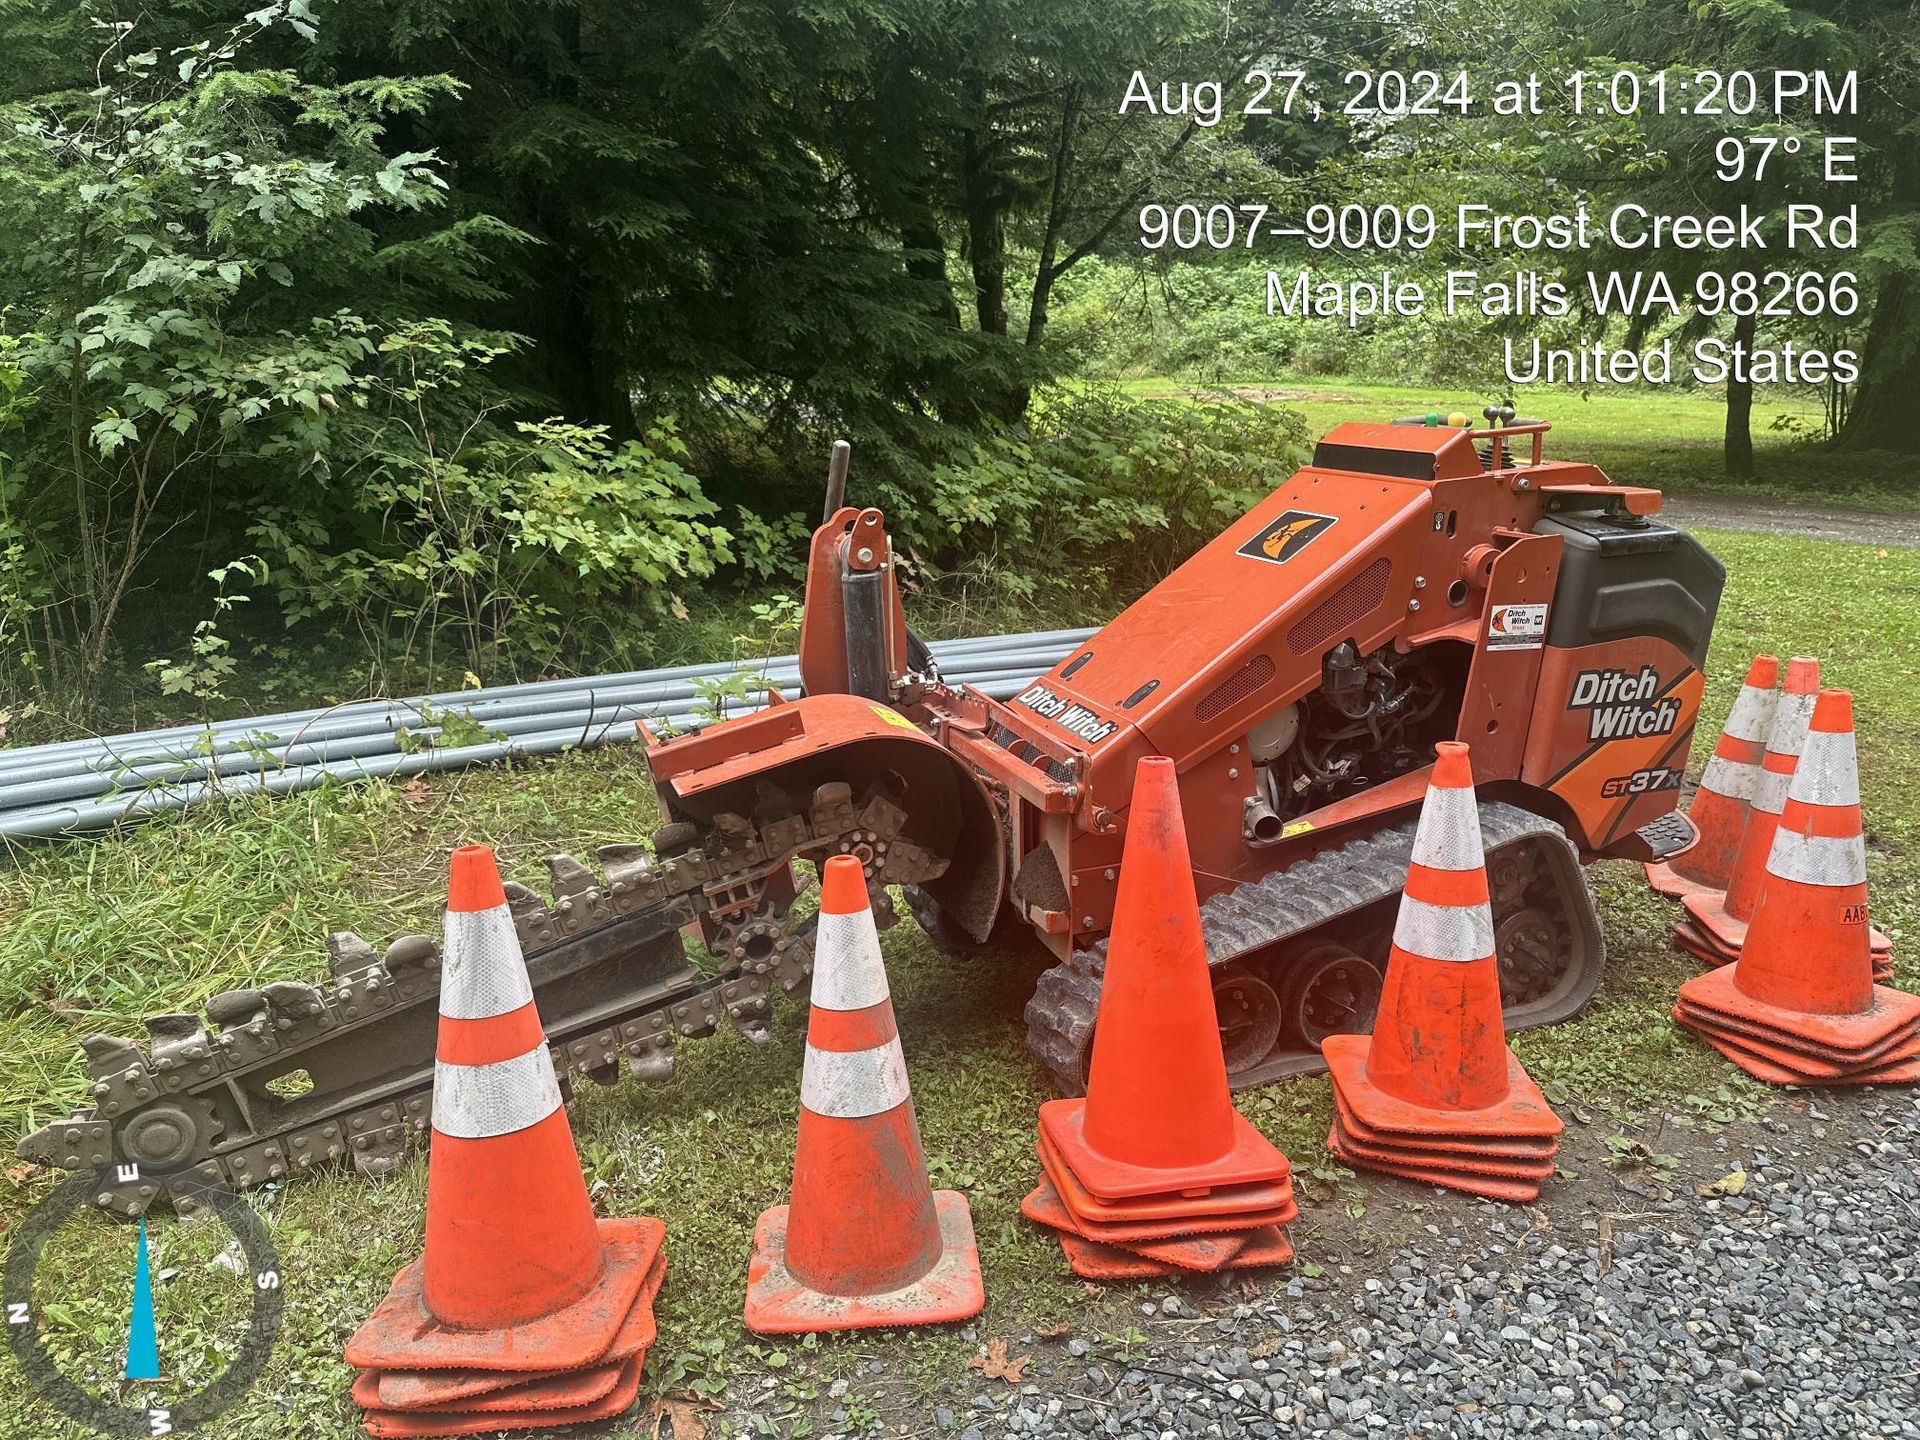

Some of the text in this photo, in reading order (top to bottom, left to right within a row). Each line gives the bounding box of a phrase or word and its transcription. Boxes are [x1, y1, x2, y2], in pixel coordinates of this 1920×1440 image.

[1511, 617, 1531, 625] Witch
[1018, 684, 1068, 718] Ditch
[1571, 667, 1657, 706] Ditch
